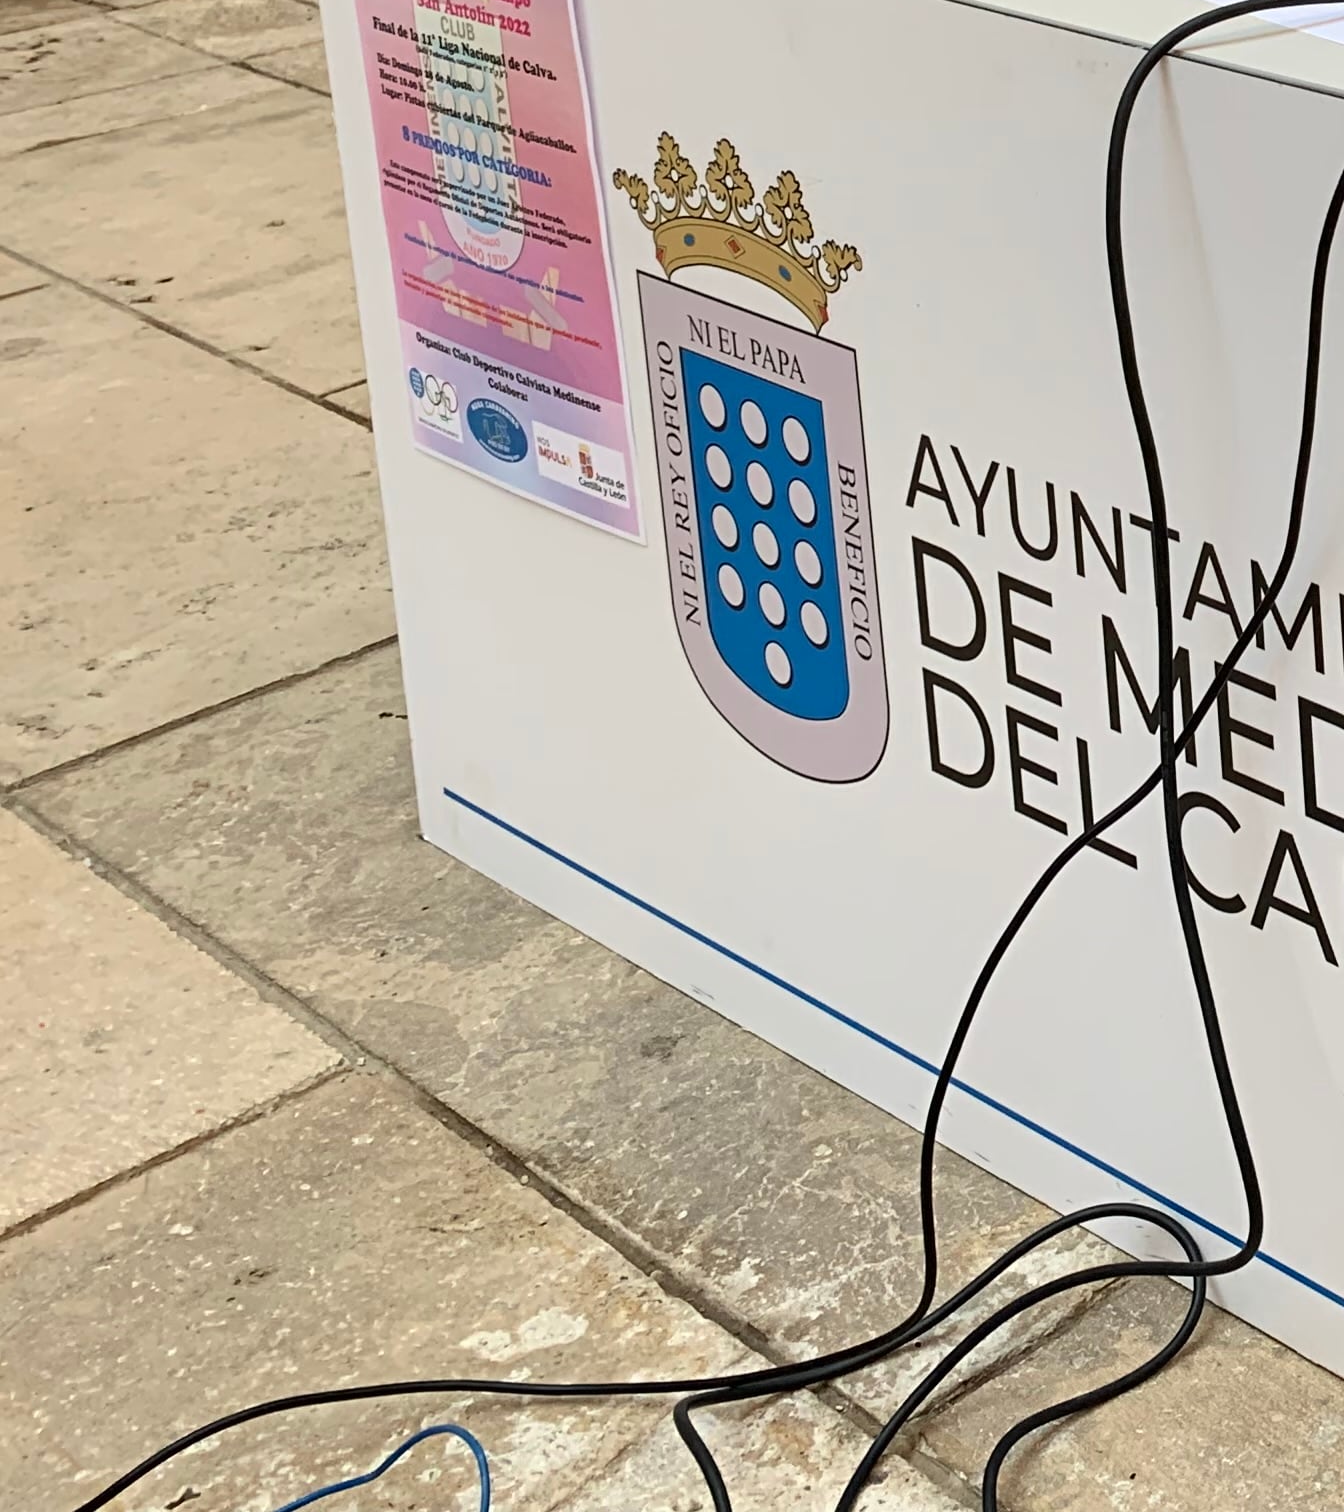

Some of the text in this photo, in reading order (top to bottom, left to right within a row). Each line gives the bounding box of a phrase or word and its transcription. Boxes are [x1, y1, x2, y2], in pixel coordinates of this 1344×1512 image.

[372, 16, 395, 35] Final
[396, 23, 408, 39] de
[410, 27, 419, 42] la
[438, 37, 458, 53] Liga
[461, 41, 506, 67] Nacional
[507, 55, 520, 71] de
[522, 60, 557, 81] Calva.
[439, 15, 475, 41] CLUB
[498, 14, 531, 36] 2022
[401, 125, 410, 141] 8
[411, 130, 456, 157] PREMIOS
[457, 144, 479, 165] POR
[686, 313, 807, 384] NI EL PAPA
[657, 340, 701, 626] NI EL REY OFICIO
[837, 464, 873, 662] BENEFICIO
[911, 535, 1063, 707] DE
[922, 667, 1138, 870] DEL
